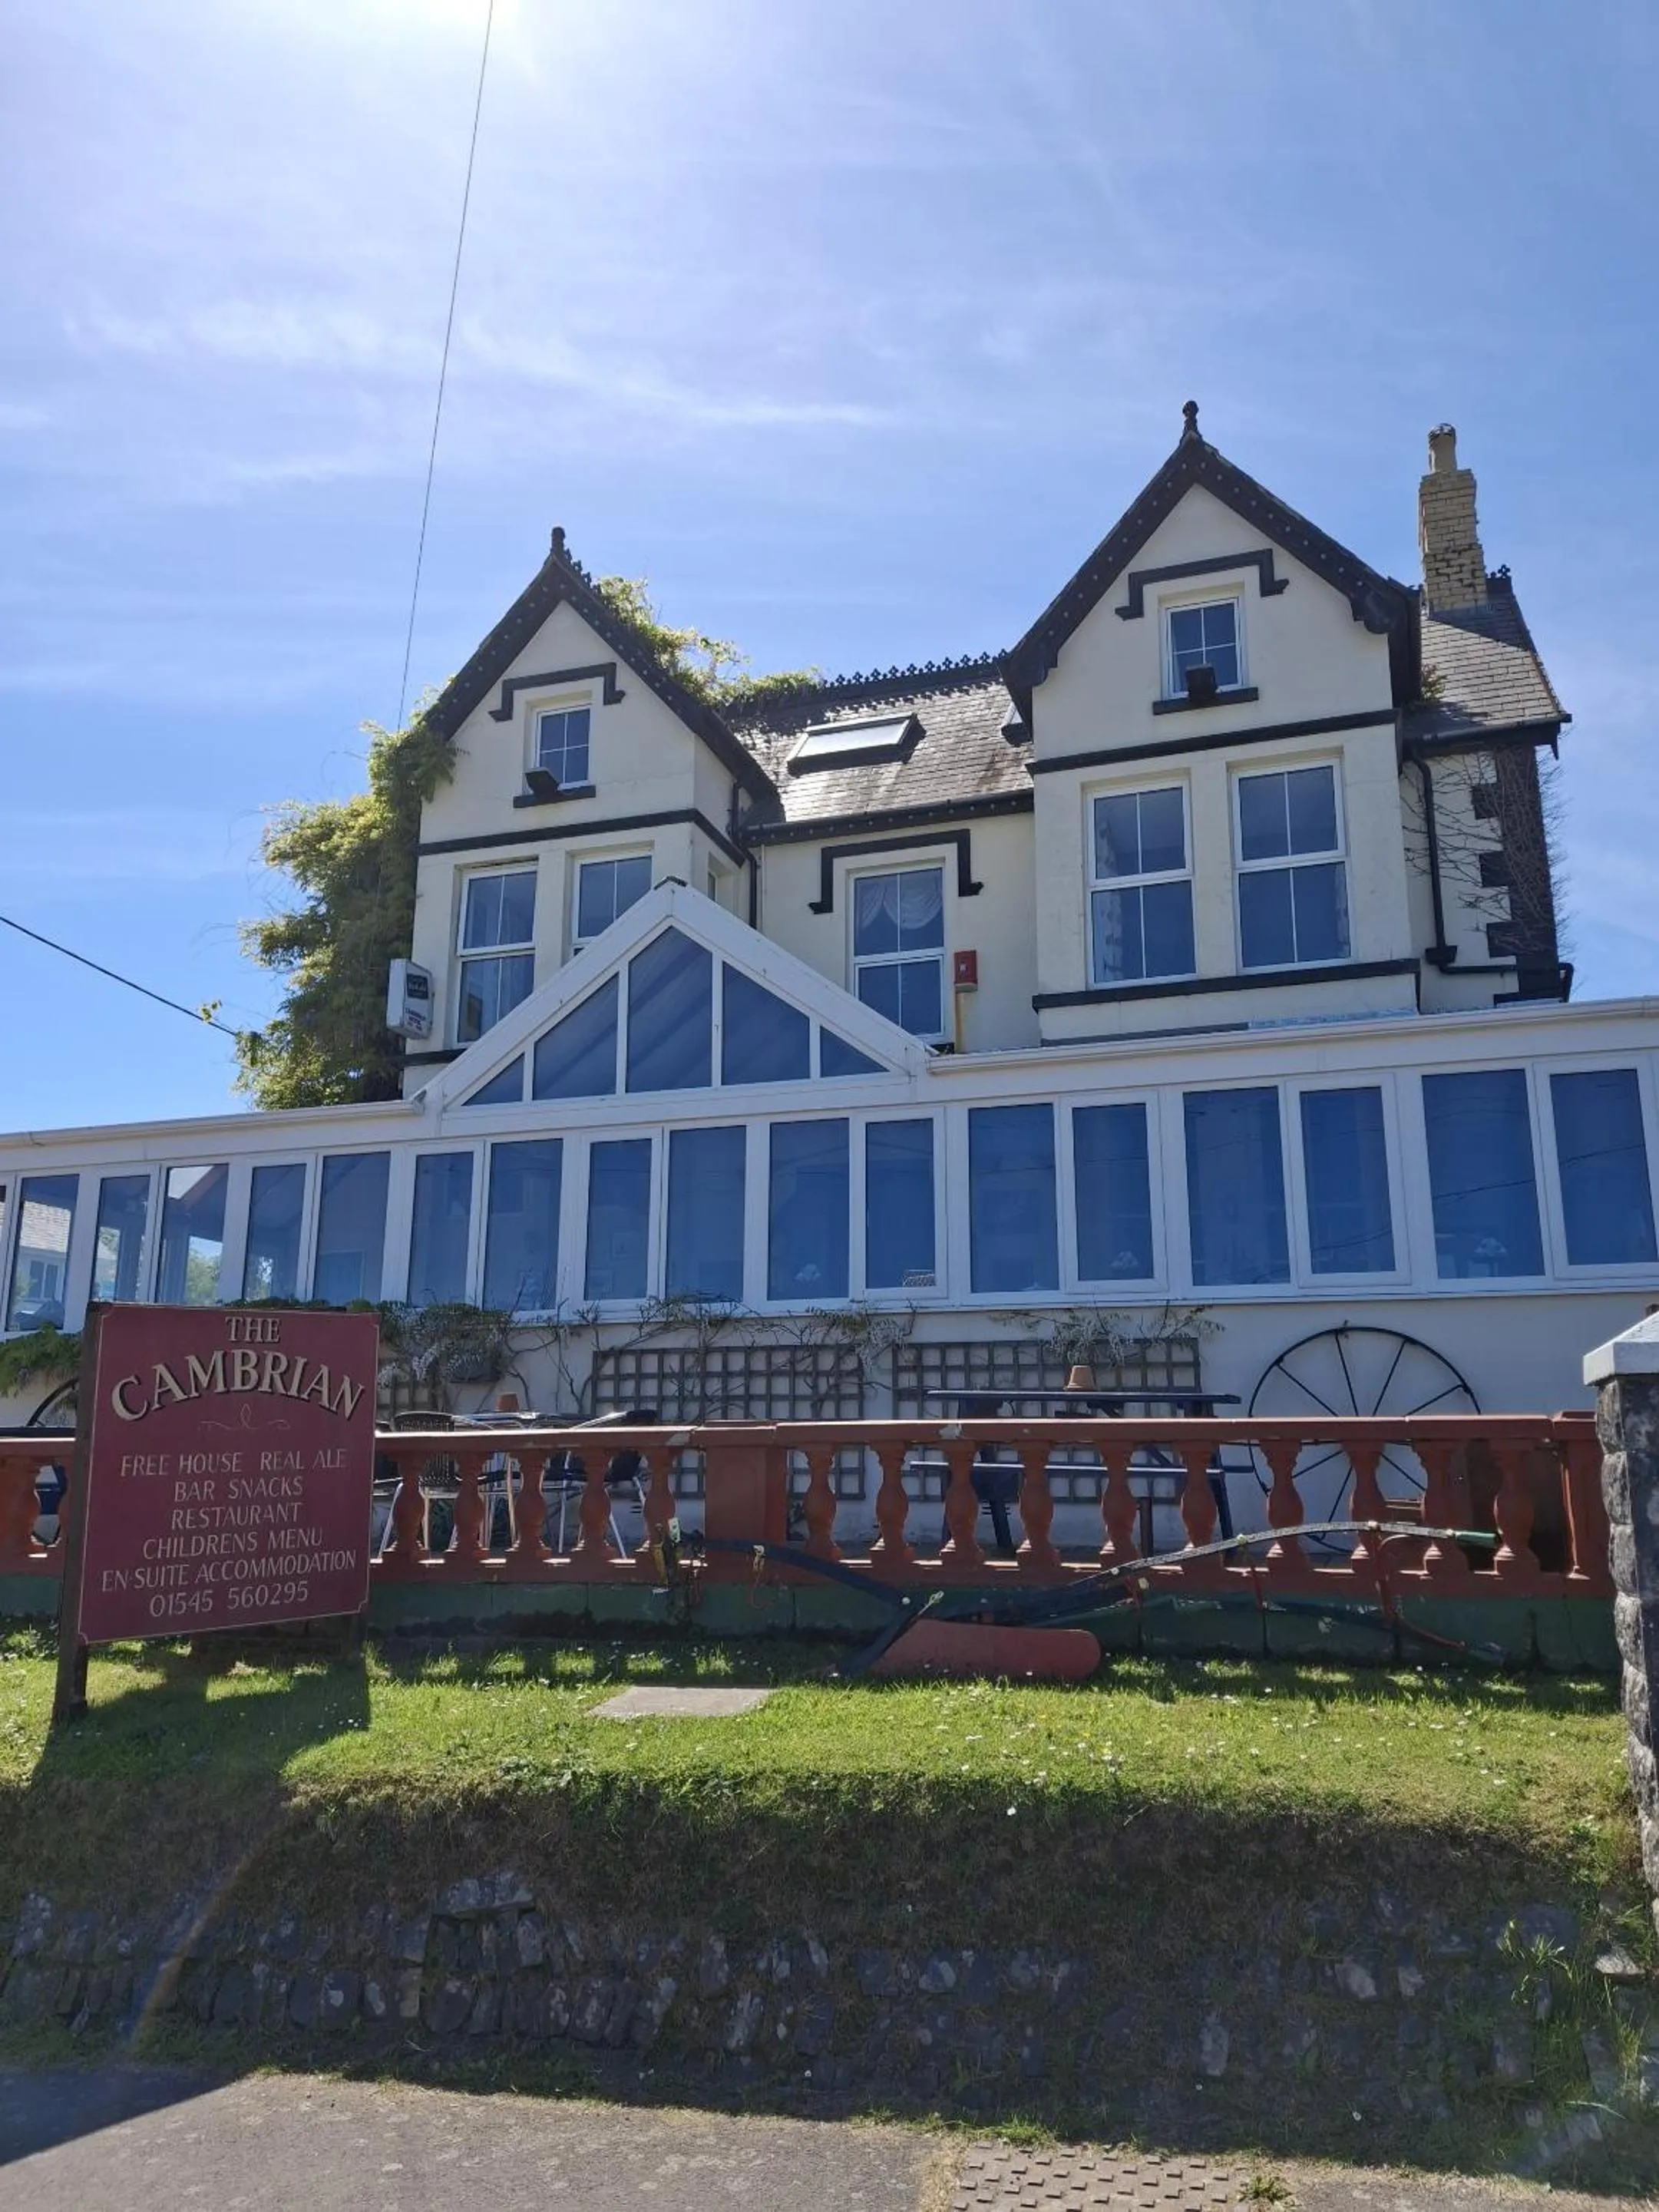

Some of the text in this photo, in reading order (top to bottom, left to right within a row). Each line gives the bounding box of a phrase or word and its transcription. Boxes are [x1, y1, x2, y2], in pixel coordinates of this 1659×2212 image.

[226, 1317, 280, 1343] THE
[111, 1349, 365, 1422] CAMBRIAN
[120, 1449, 347, 1477] FREE HOUSE REAL ALE
[174, 1477, 302, 1503] BAR SNACKS
[171, 1503, 303, 1530] RESTAURANT
[143, 1529, 322, 1560] CHILDRENS MENU
[195, 1550, 356, 1583] ACCOMMODATION
[150, 1581, 308, 1617] 01545 560295
